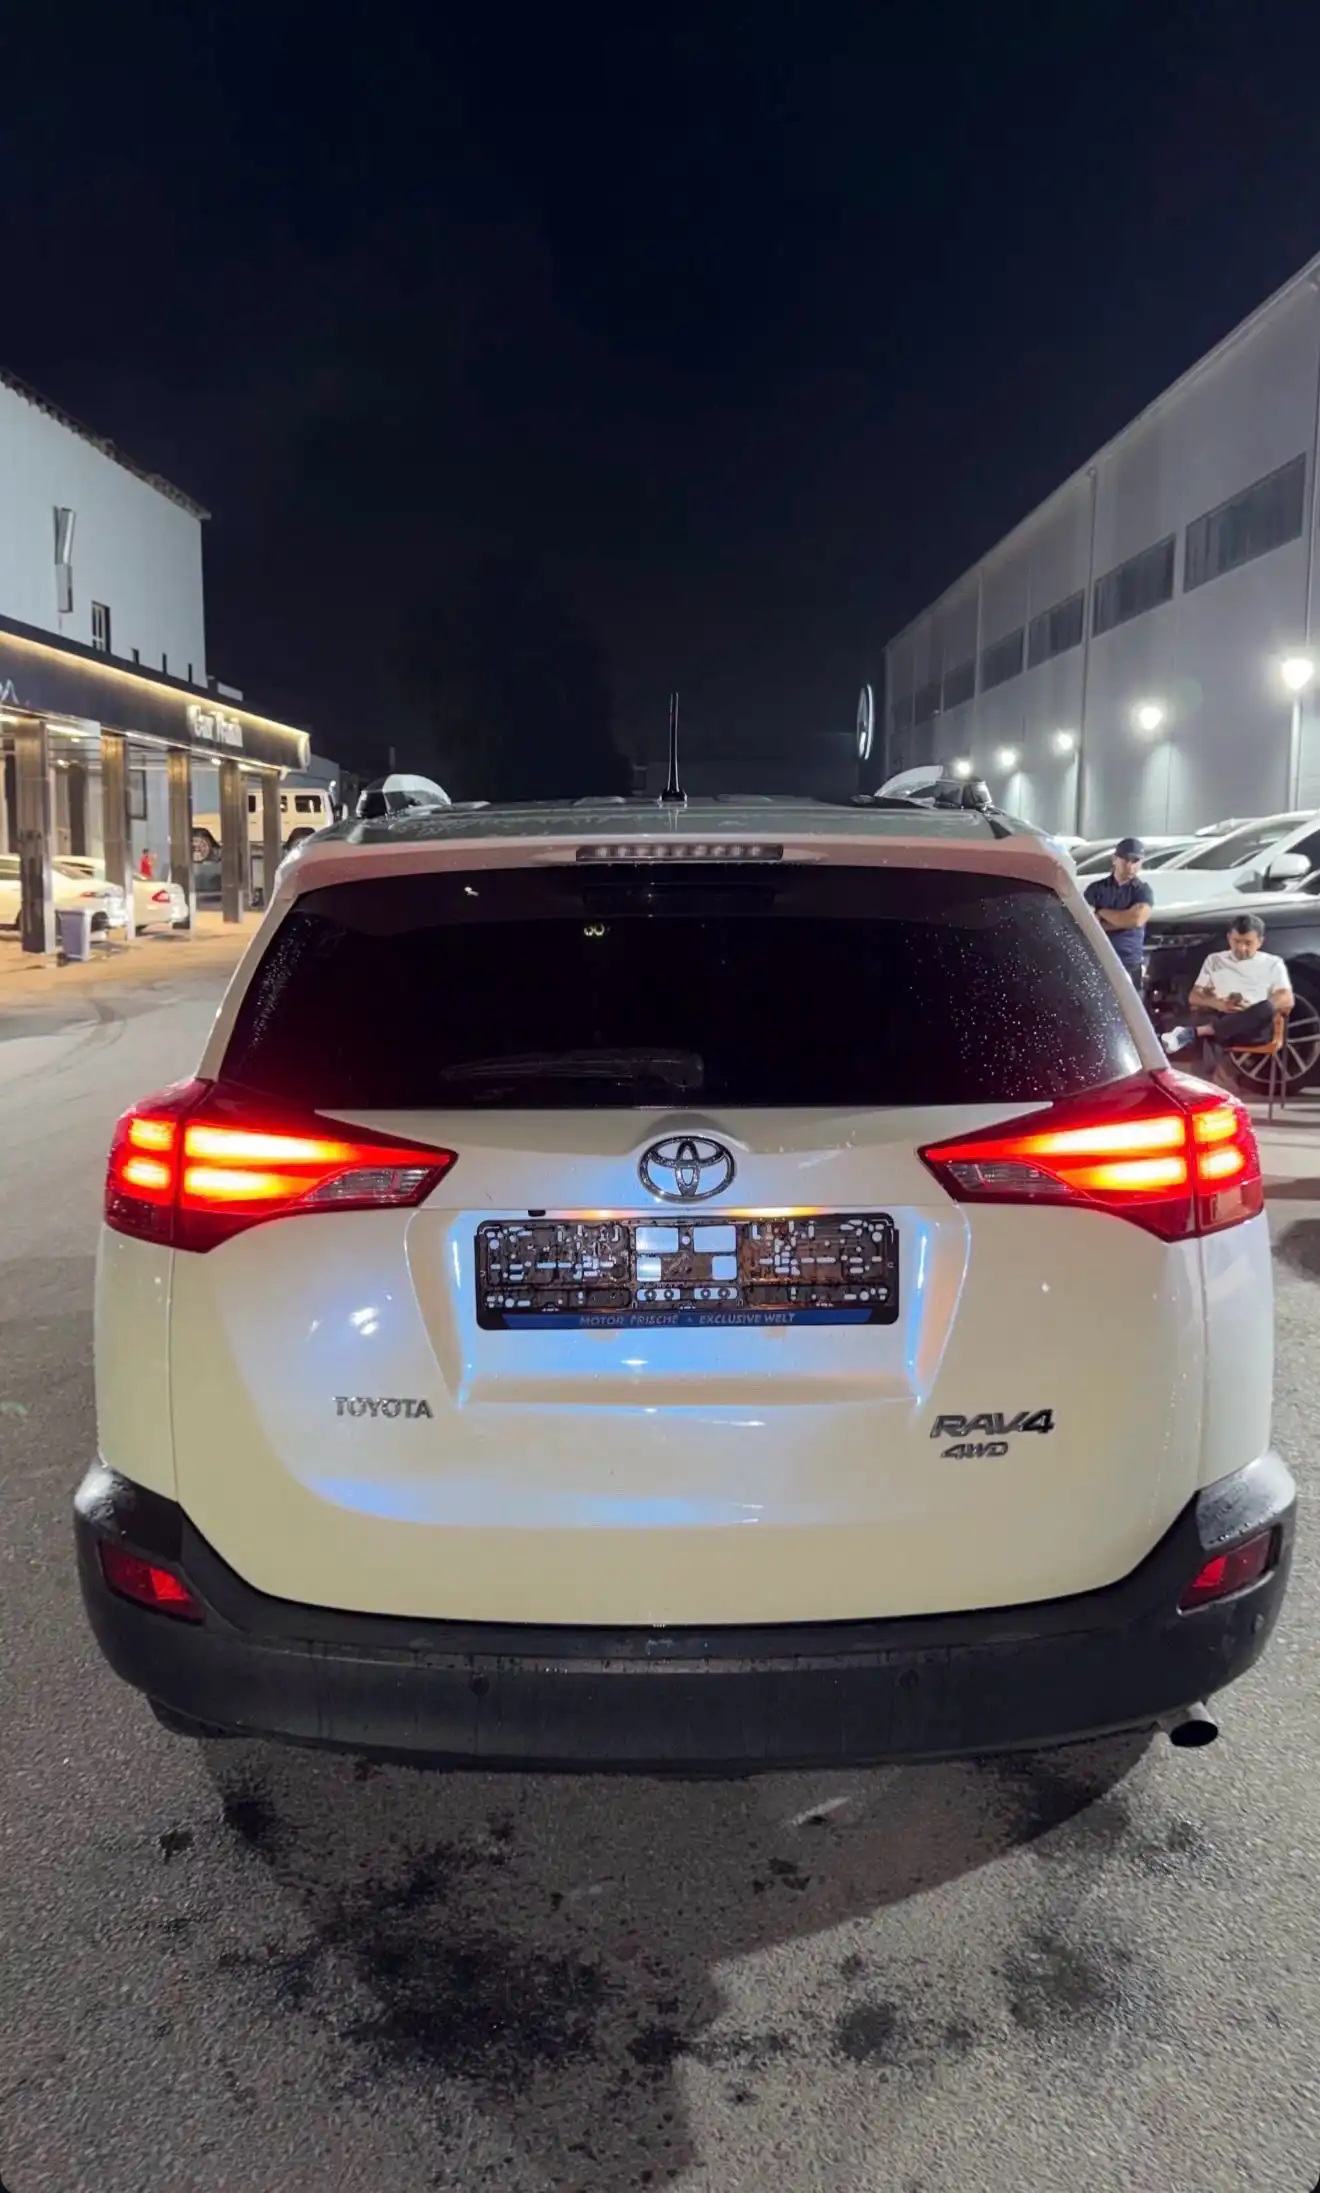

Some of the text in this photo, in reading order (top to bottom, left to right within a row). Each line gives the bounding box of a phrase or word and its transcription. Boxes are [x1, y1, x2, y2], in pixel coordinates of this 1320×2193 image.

[580, 1314, 624, 1326] MOTOR
[700, 1312, 762, 1325] EXCLUSIVE
[764, 1311, 796, 1323] WELT
[332, 1396, 434, 1419] TOYOTA
[930, 1408, 1055, 1438] RAV4
[940, 1441, 1009, 1460] 4WD
